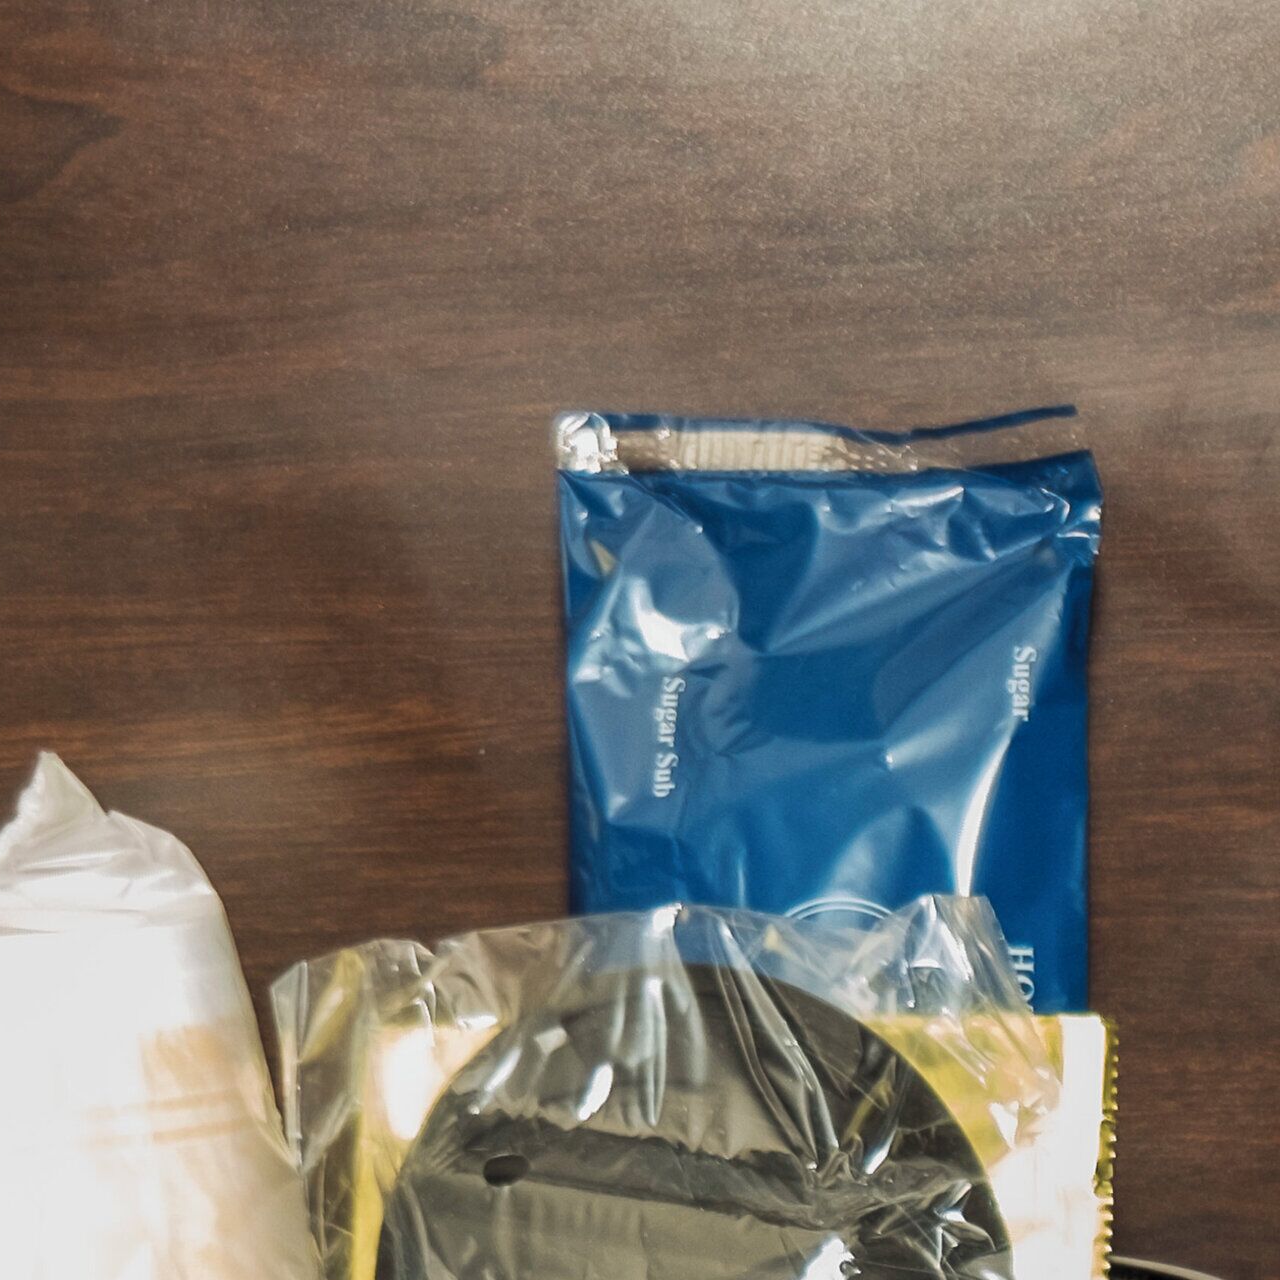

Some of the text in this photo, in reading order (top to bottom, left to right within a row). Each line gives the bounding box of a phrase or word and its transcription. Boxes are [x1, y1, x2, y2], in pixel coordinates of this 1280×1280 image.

[1006, 645, 1037, 722] Sugar
[652, 677, 686, 798] Sugar Sub
